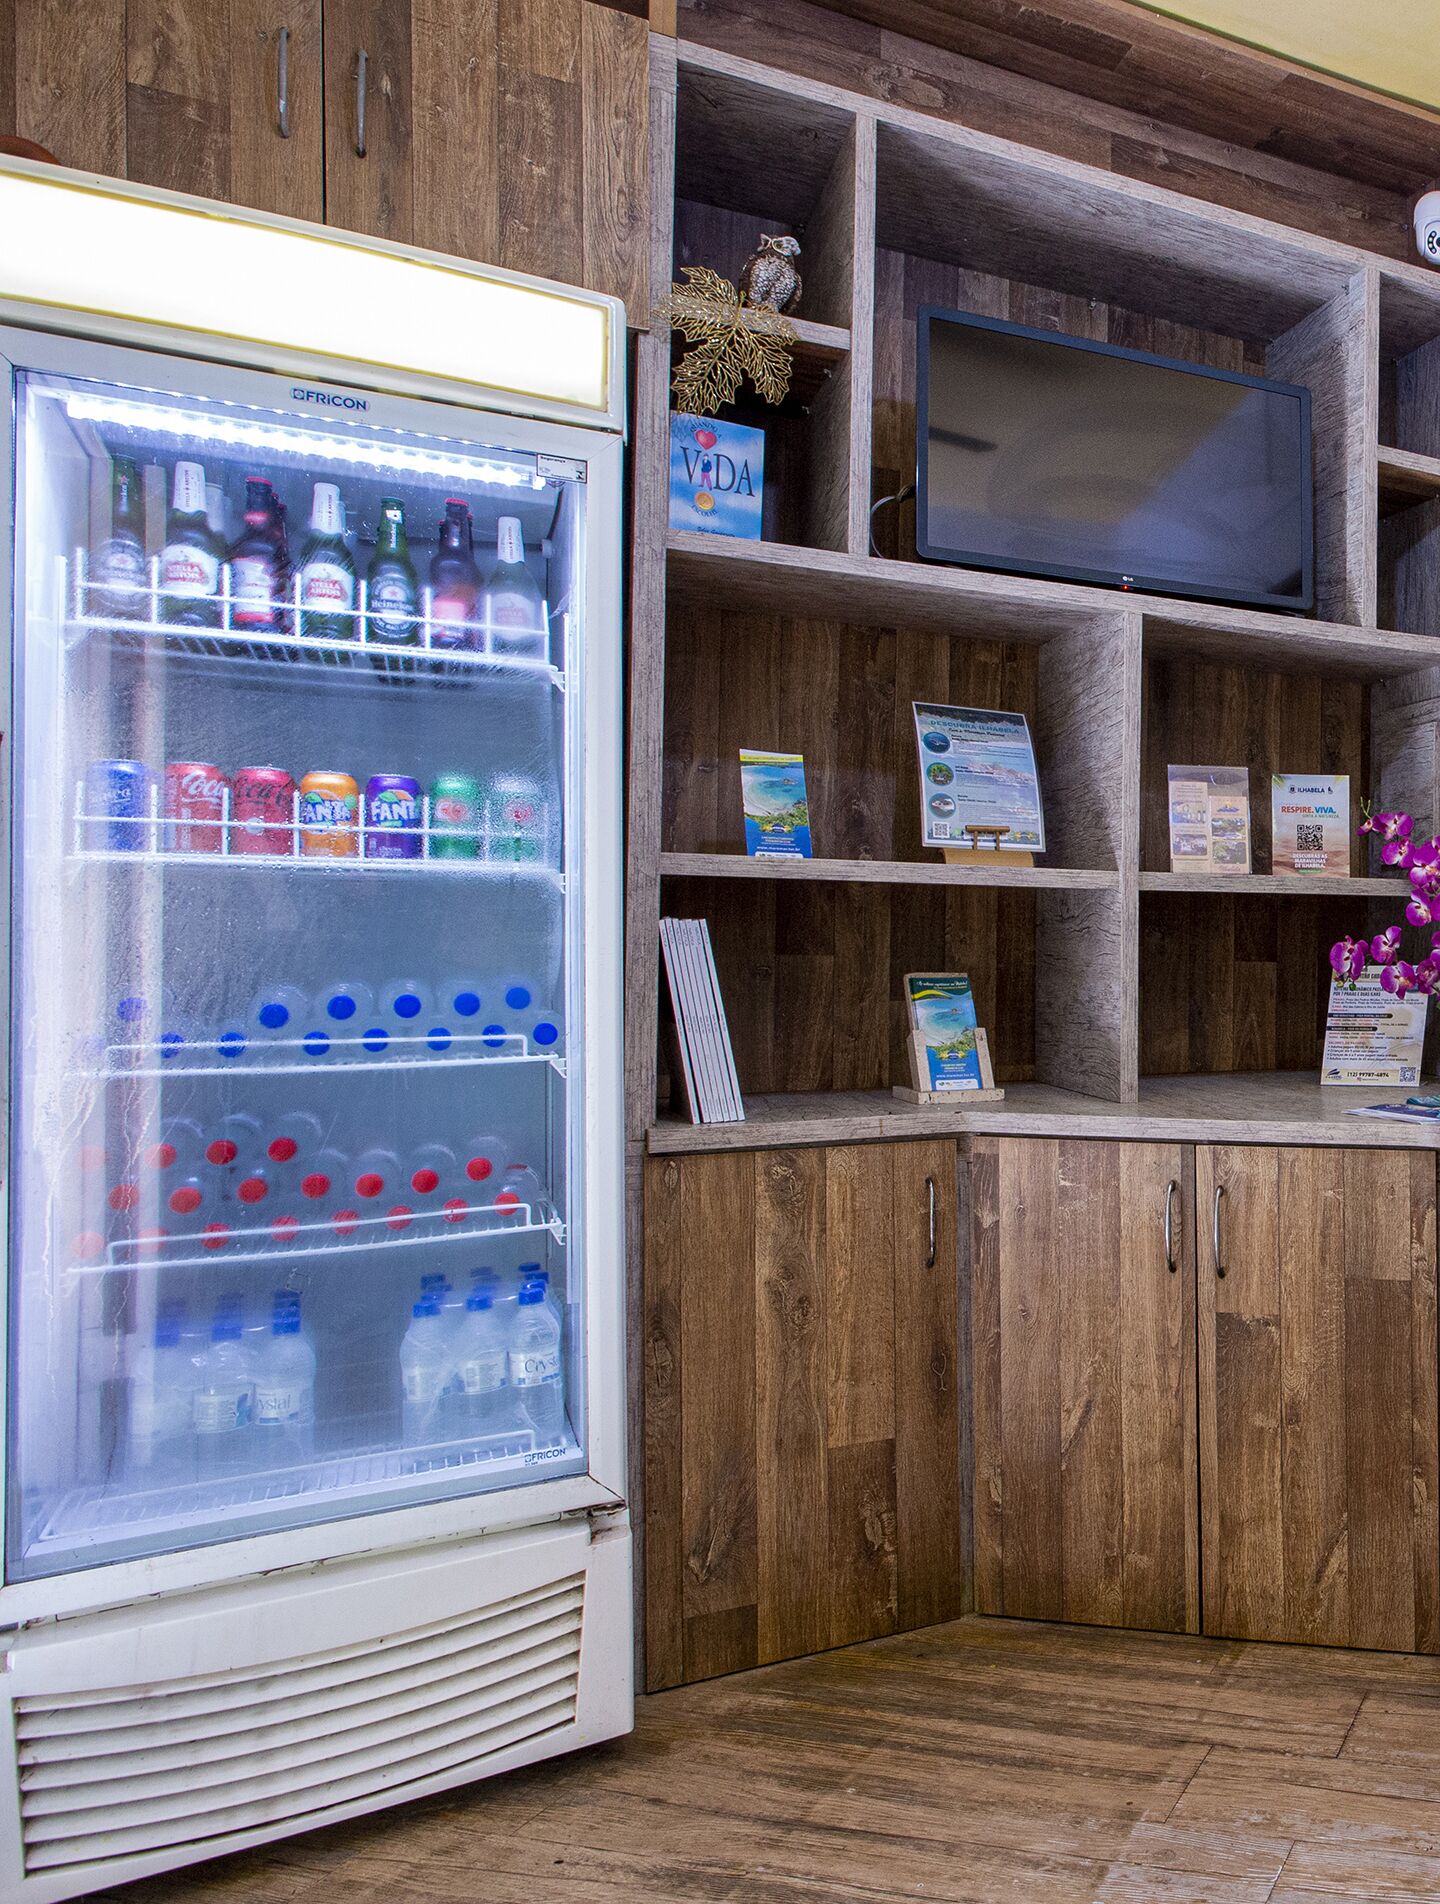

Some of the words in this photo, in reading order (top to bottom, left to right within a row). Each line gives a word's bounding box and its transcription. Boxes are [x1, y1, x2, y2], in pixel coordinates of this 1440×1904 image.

[310, 581, 340, 591] STELLA
[930, 719, 977, 731] DESCUBRA
[978, 724, 1020, 735] ILHABELA
[1281, 805, 1314, 814] RESPIRE.
[1314, 806, 1337, 814] VIVA.
